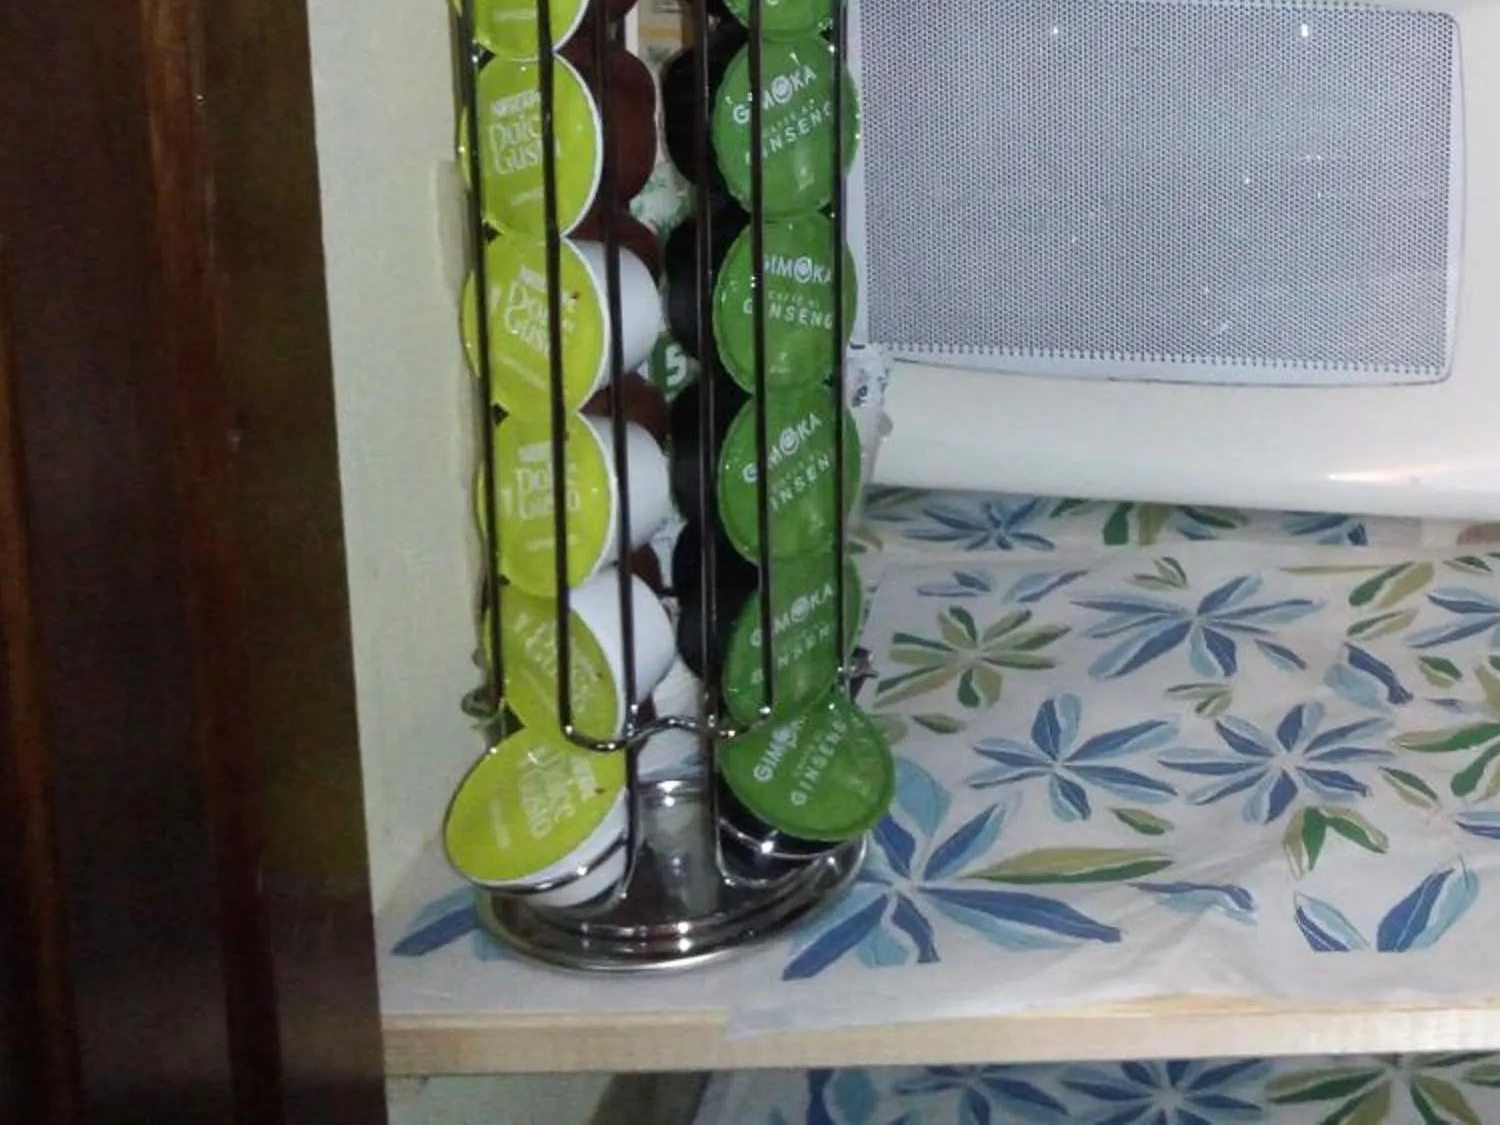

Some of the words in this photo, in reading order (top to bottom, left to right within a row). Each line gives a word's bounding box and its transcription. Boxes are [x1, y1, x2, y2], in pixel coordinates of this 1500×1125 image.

[732, 66, 818, 125] GMOKA
[743, 298, 834, 330] GNSENG
[742, 413, 823, 484] GMOKA
[750, 583, 834, 647] GMOKA
